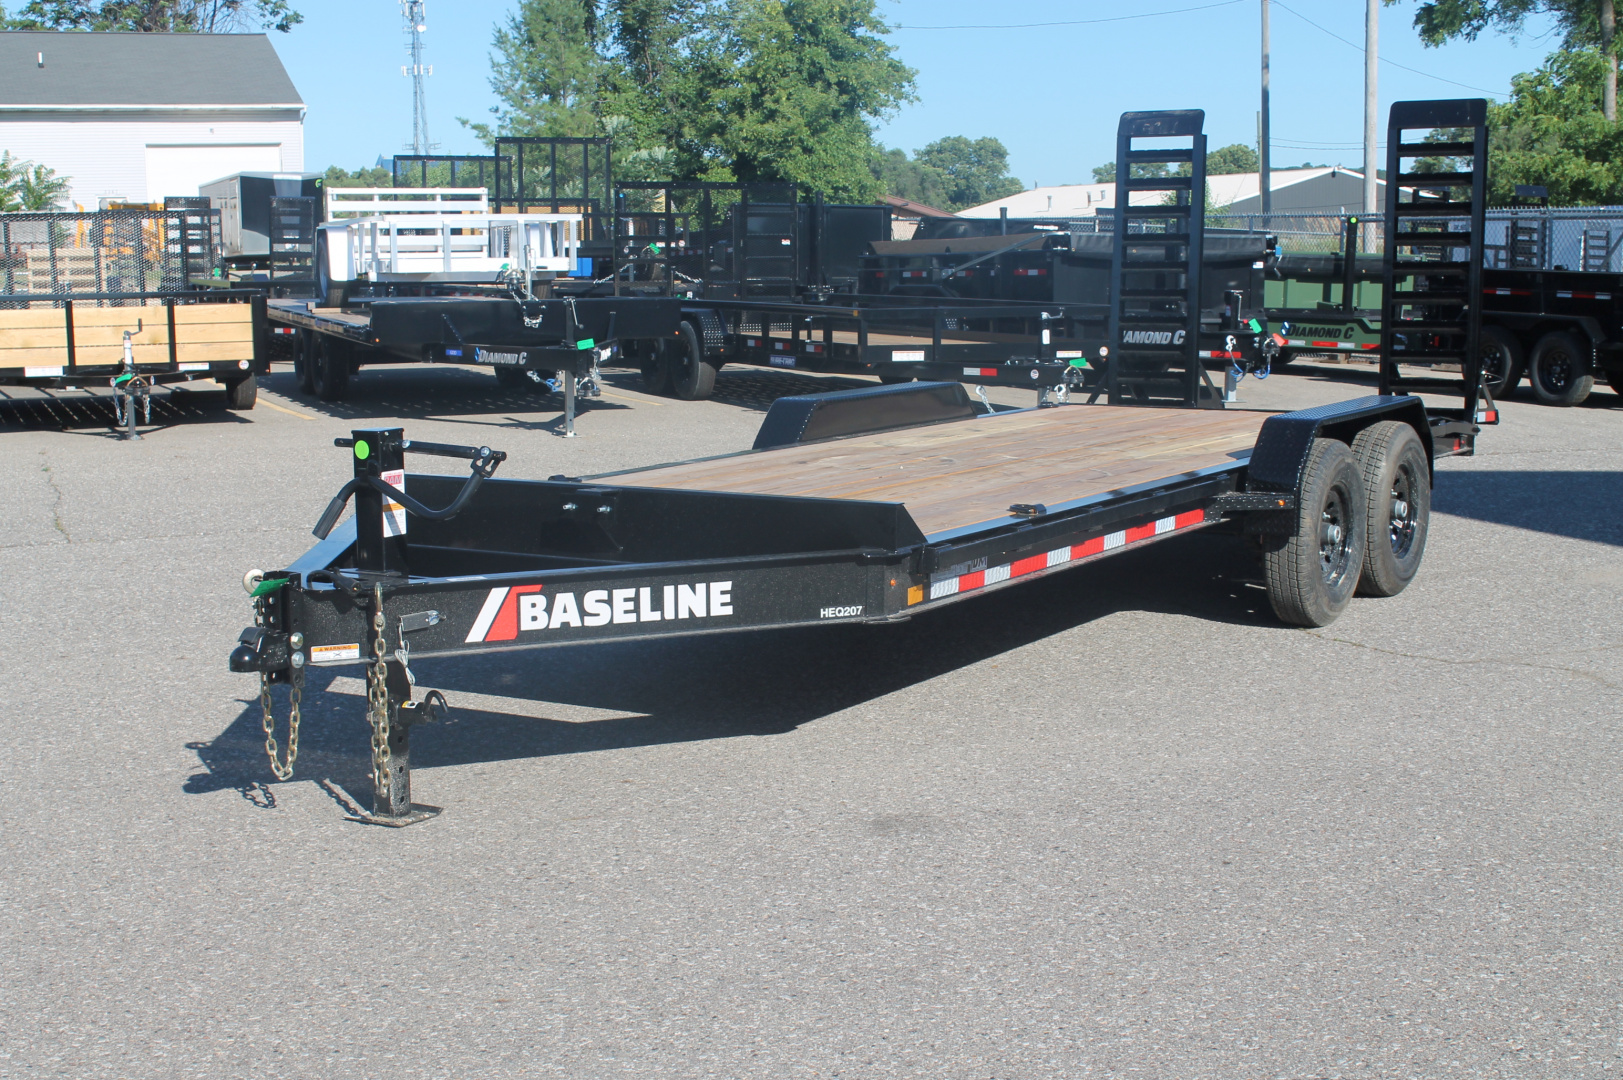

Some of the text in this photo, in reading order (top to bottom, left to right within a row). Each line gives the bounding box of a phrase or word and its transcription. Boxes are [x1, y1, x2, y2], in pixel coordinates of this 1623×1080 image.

[1123, 329, 1186, 345] AMOND C
[1287, 324, 1355, 339] DIAMOND C
[478, 350, 528, 365] DIAMOND C
[519, 580, 734, 631] BASELINE
[820, 605, 863, 619] HEQ207
[324, 644, 352, 652] WARNING
